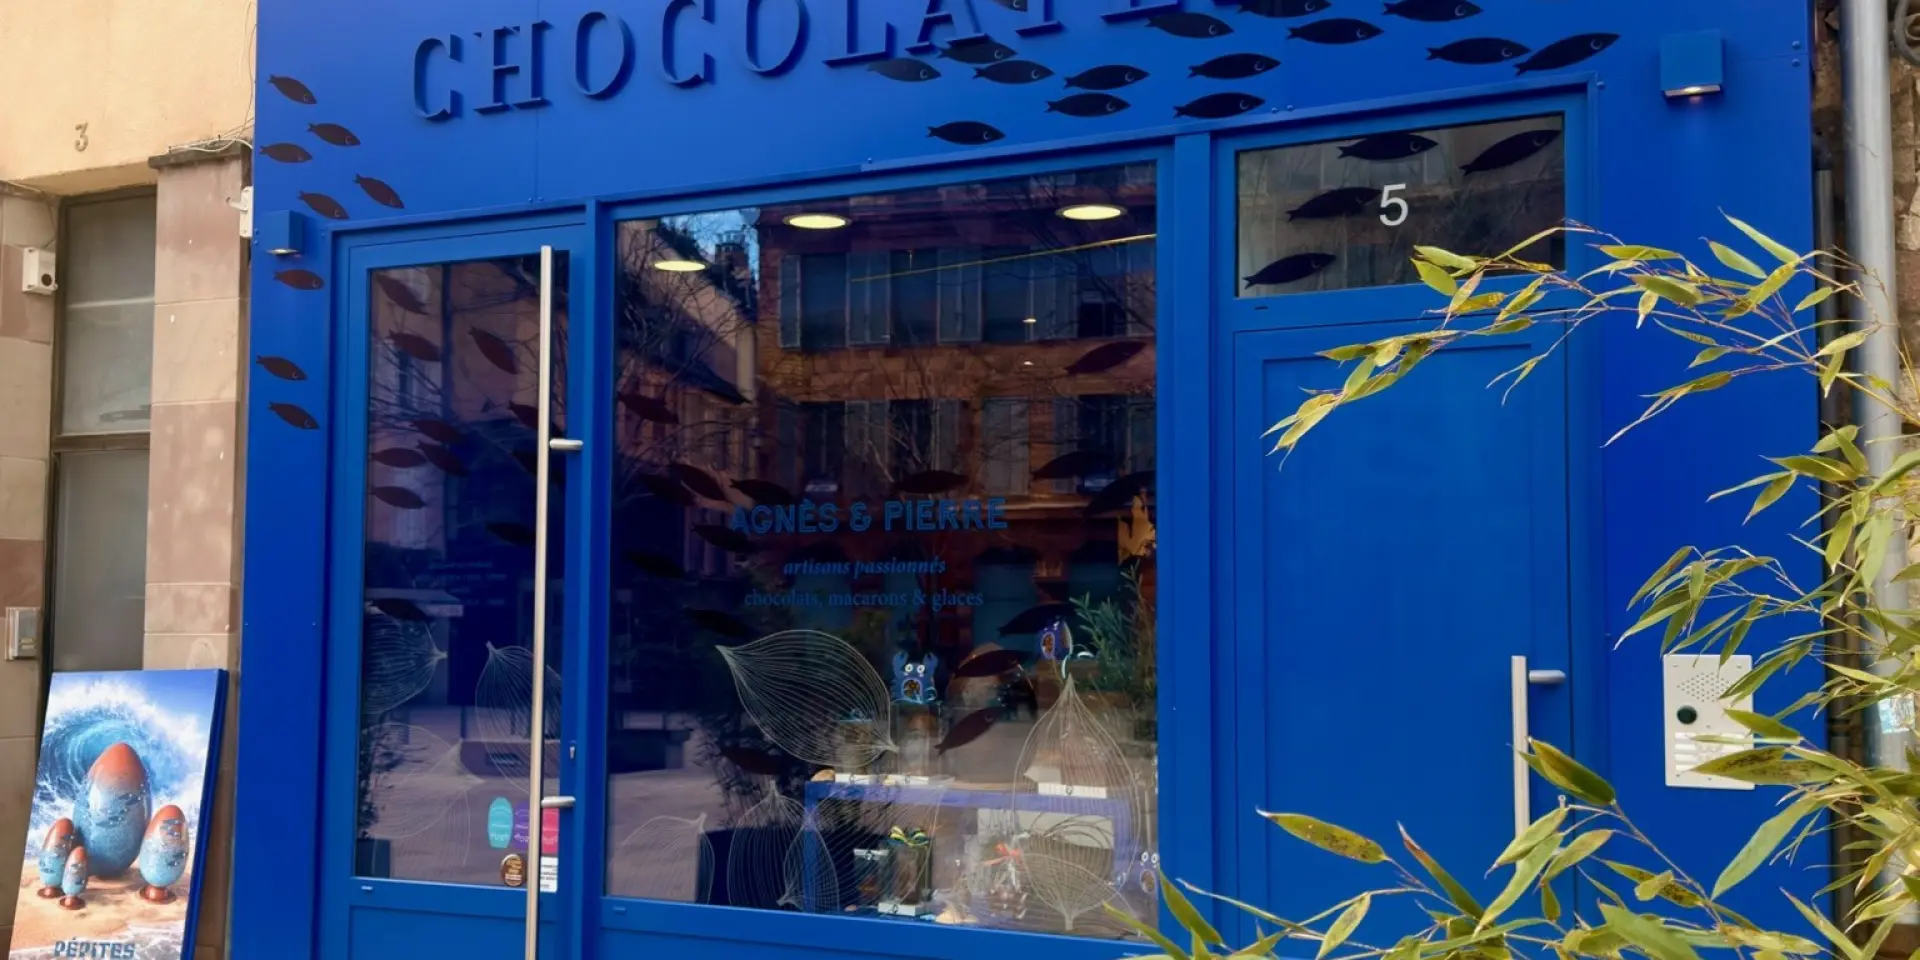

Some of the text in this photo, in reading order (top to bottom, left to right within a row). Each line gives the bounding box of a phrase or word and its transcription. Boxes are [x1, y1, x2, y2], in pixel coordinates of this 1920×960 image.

[413, 0, 1244, 122] CHOCOLA
[74, 122, 89, 152] 3
[1379, 183, 1409, 226] 5
[731, 496, 1009, 535] AGNÈS & PIERRE
[783, 556, 946, 579] artisans passionnés
[744, 589, 984, 612] chocolats, macarons & glaces
[54, 936, 136, 959] PÉPITES
